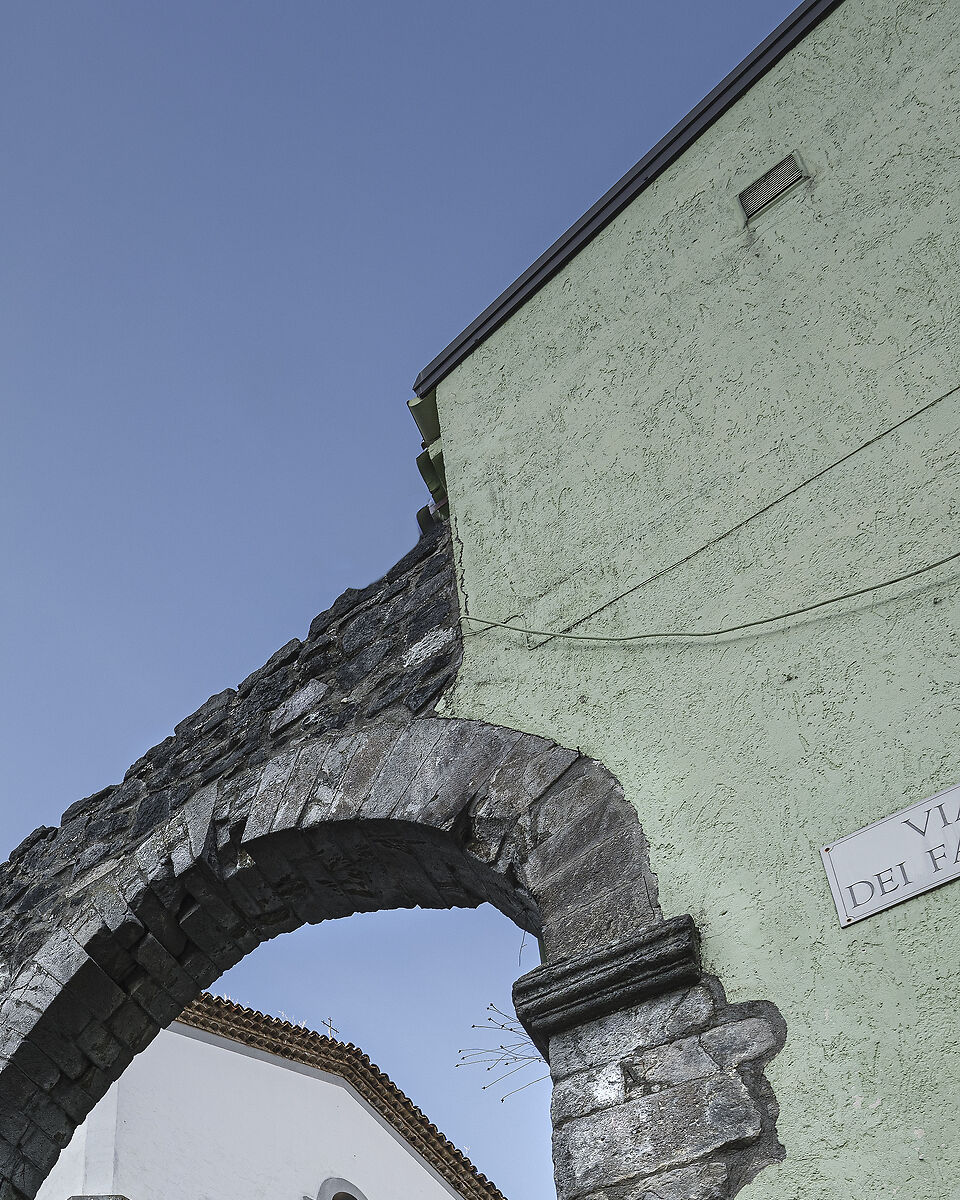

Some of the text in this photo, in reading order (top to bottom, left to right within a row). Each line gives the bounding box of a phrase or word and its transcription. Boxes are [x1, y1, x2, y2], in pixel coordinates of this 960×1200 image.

[901, 803, 960, 837] VI
[845, 838, 960, 909] DEI F
